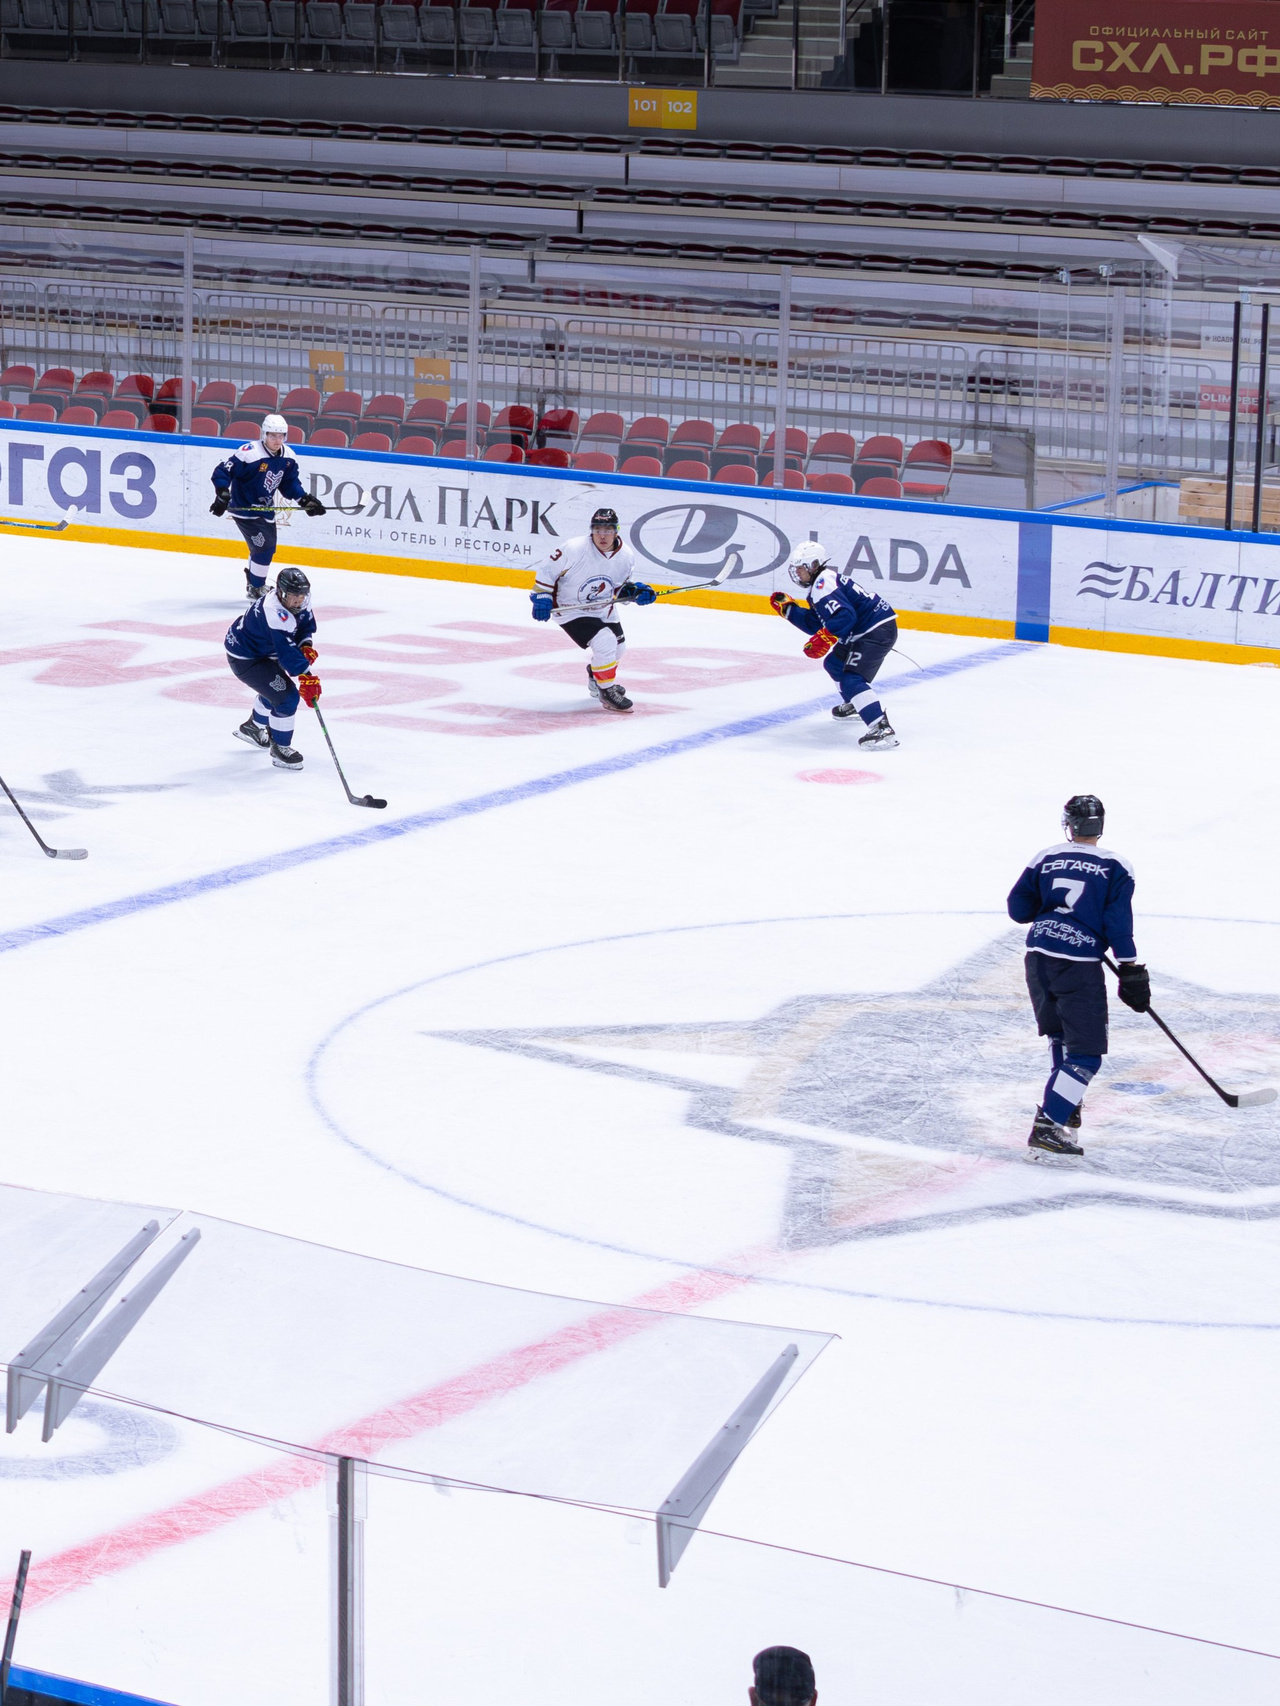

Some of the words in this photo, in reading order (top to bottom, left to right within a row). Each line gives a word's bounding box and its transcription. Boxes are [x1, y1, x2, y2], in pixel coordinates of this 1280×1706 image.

[1089, 25, 1220, 40] ОФИЦИАЛЬНЫЙ
[1225, 28, 1269, 41] САЙТ
[1072, 40, 1280, 77] СХЛ.РФ
[633, 99, 657, 112] 101
[667, 101, 693, 113] 102
[309, 472, 424, 523] РОЯЛ
[435, 485, 561, 537] ПАРК
[335, 525, 372, 539] ПАРК
[390, 531, 437, 546] ОТЕЛЬ
[455, 538, 532, 556] РЕСТОРАН
[550, 549, 562, 561] 3
[824, 599, 841, 615] 12
[846, 651, 862, 667] 12
[1051, 878, 1085, 914] 7
